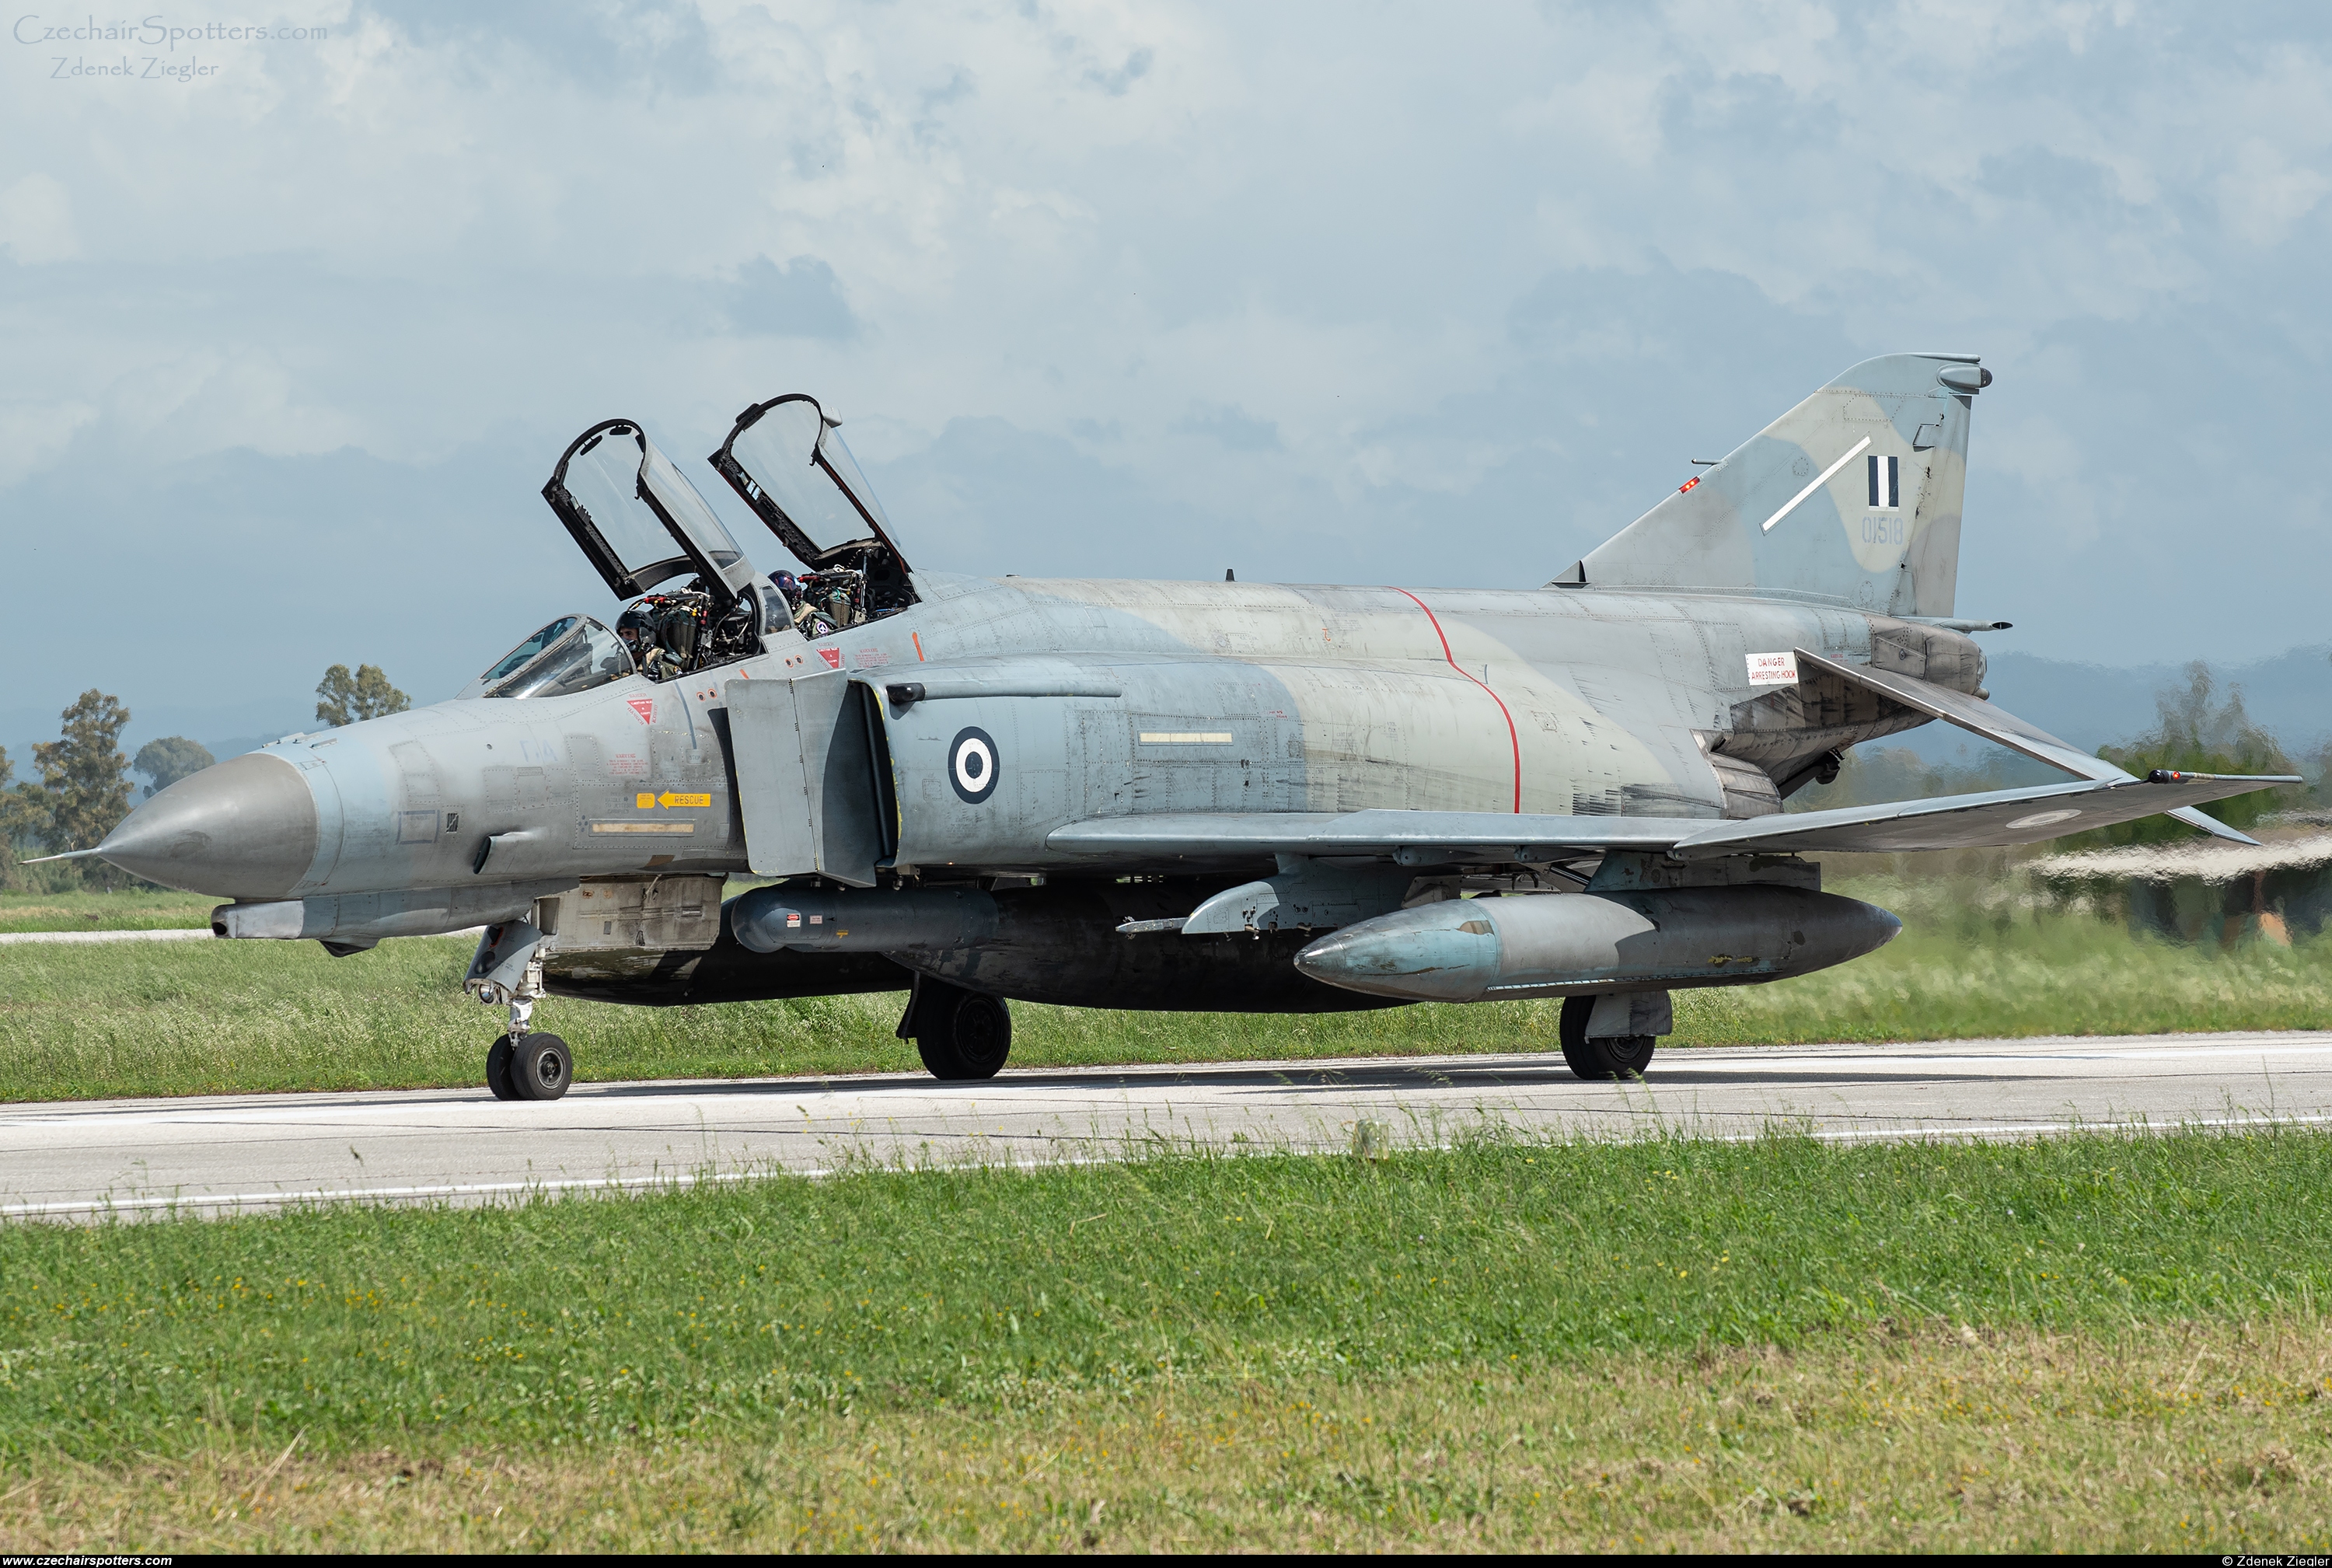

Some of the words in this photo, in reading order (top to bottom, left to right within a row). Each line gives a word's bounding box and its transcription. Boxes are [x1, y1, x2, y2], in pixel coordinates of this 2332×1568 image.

[1862, 516, 1904, 545] 01518
[1758, 657, 1785, 667] DANGER
[1751, 670, 1781, 680] ARRESTING
[1781, 669, 1796, 679] HOOK
[674, 795, 703, 805] RESCUE
